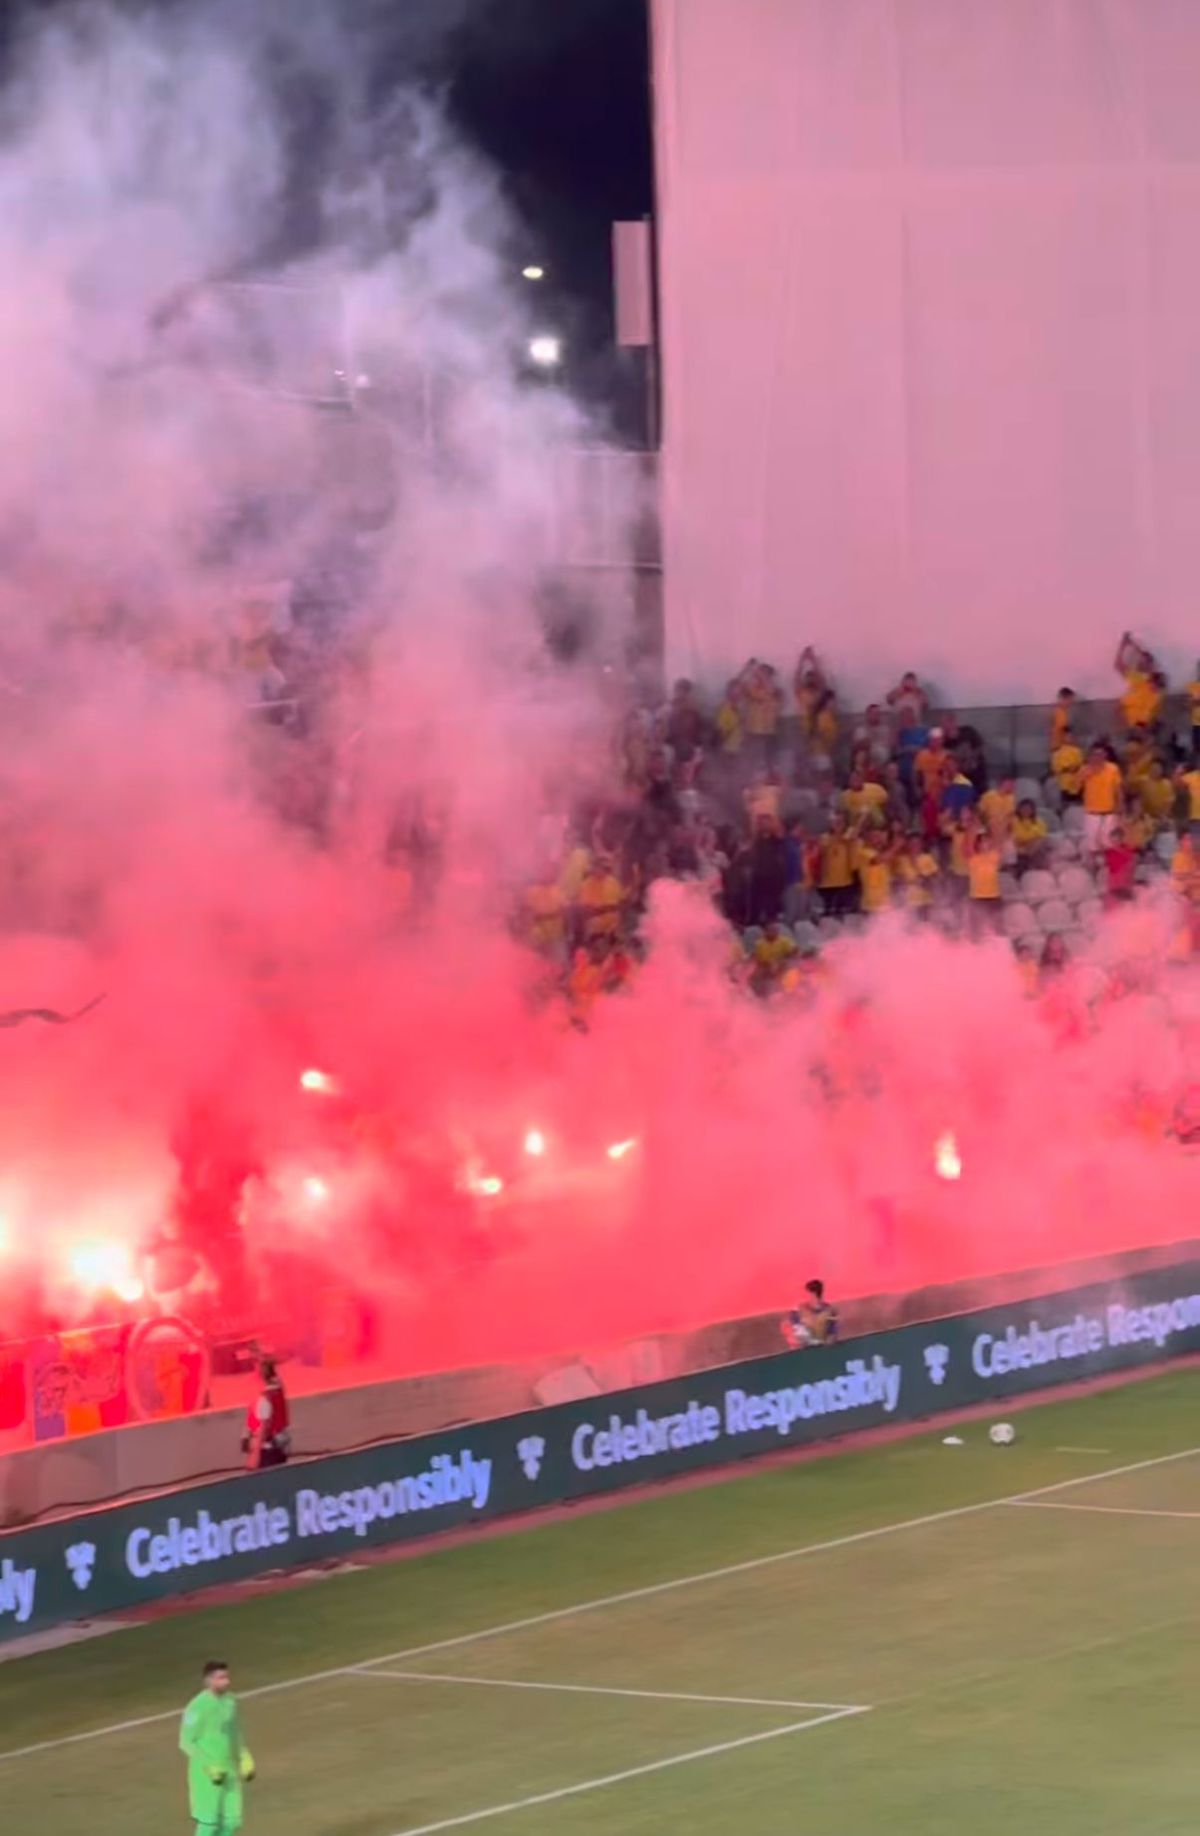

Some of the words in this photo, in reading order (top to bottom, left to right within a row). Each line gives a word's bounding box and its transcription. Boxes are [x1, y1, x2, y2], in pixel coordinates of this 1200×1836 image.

[972, 1315, 1102, 1378] Celebrate
[571, 1401, 720, 1470] Celebrate
[724, 1355, 900, 1435] Responsibly
[126, 1504, 289, 1578] Celebrate
[296, 1449, 492, 1536] Responsibly
